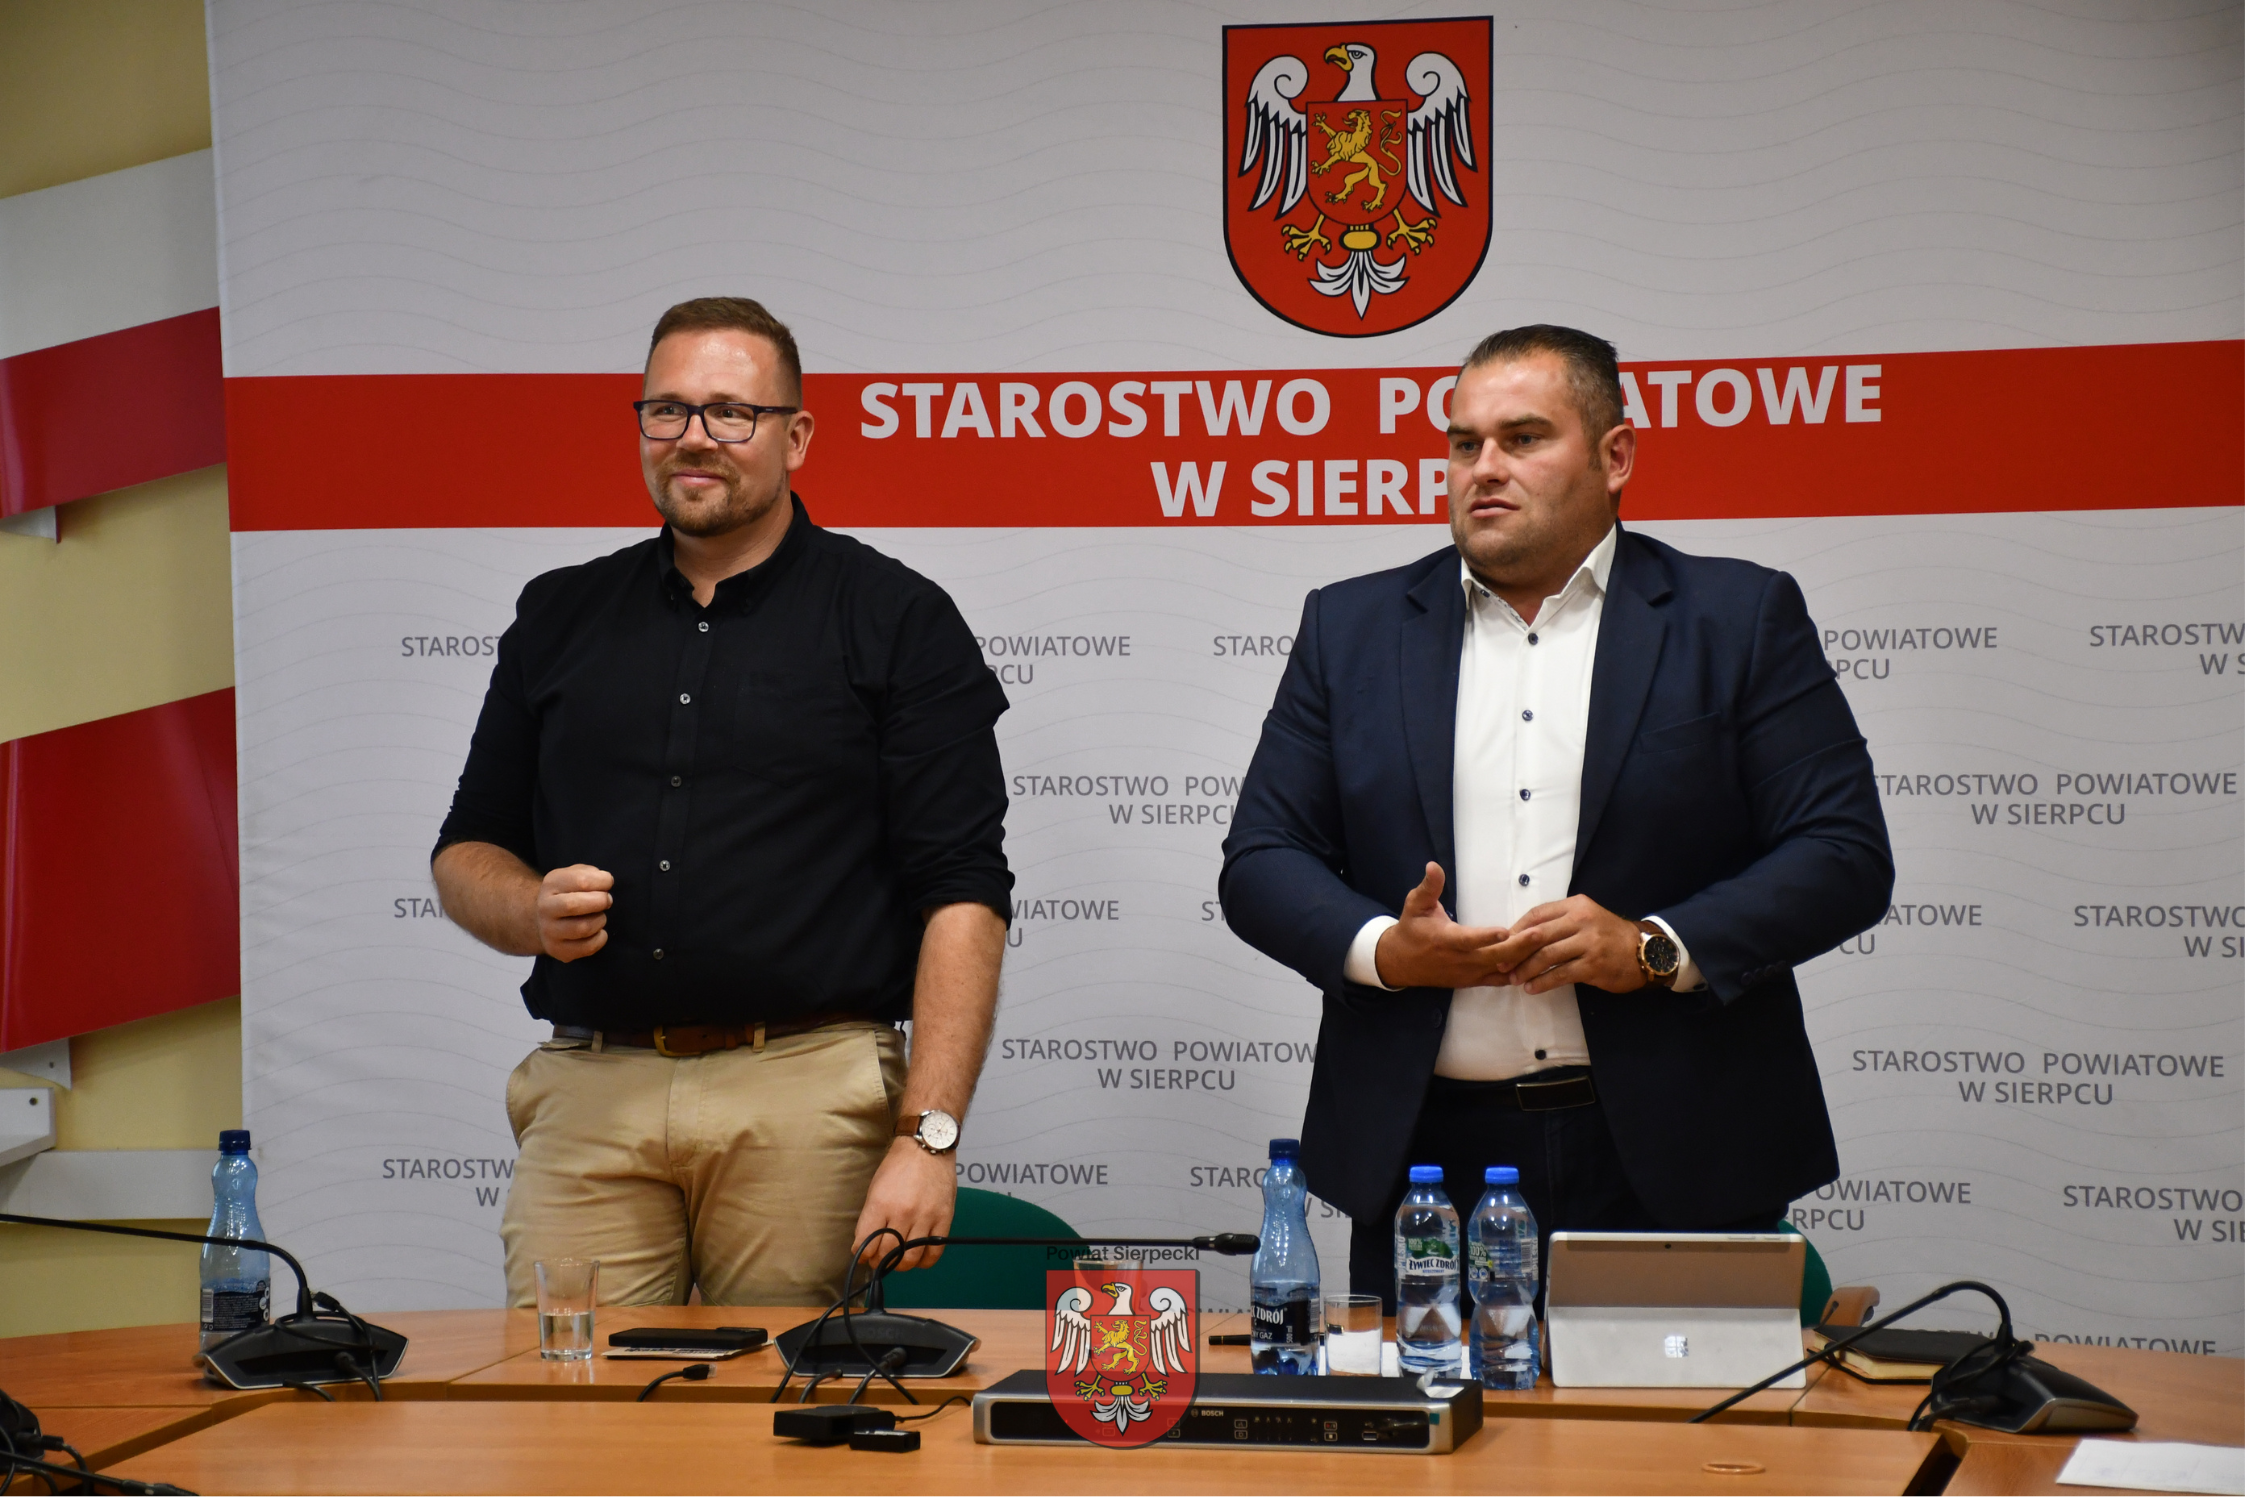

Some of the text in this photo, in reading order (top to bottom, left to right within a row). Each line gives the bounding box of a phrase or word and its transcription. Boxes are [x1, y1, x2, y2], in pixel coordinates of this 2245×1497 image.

[860, 379, 1331, 440] STAROSTWO
[1151, 458, 1449, 517] W SIERP
[401, 635, 500, 658] STAROS
[1213, 635, 1294, 657] STARO
[1823, 627, 1998, 651] POWIATOWE
[2089, 623, 2245, 647] STAROSTW
[2200, 654, 2227, 676] W
[1012, 775, 1169, 797] STAROSTWO
[2056, 773, 2237, 796] POWIATOWE
[1108, 804, 1236, 825] W SIERPC
[1971, 803, 2126, 825] W SIERPCU
[1884, 904, 1982, 925] ATOWE
[2184, 936, 2212, 958] W
[1001, 1039, 1315, 1063] STAROSTWO POWIATOW
[1852, 1050, 2225, 1077] STAROSTWO POWIATOWE
[1097, 1068, 1235, 1090] W SIERPCU
[1958, 1081, 2113, 1106] W SIERPCU
[381, 1158, 513, 1180] STAROSTW
[475, 1186, 499, 1207] W
[1814, 1180, 1972, 1204] OWIATOWE
[2063, 1185, 2243, 1213] STAROSTWO
[2174, 1218, 2202, 1241] W
[1256, 1306, 1284, 1325] ZDRÓJ
